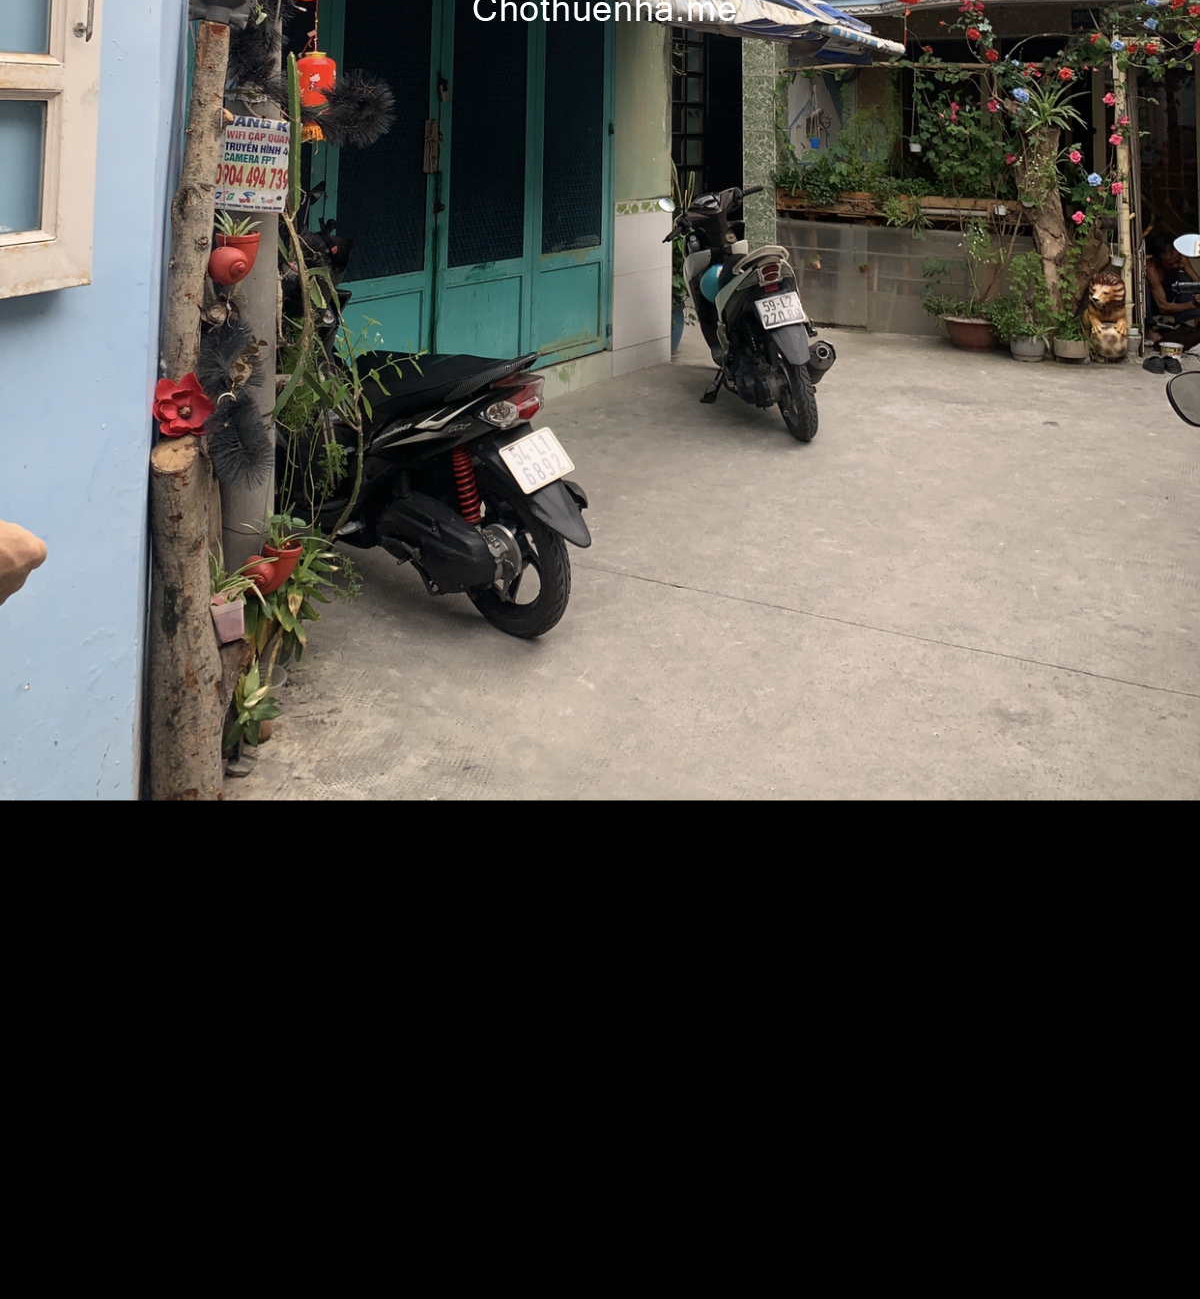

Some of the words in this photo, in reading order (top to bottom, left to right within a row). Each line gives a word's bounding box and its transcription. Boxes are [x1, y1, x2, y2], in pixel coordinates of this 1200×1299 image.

[224, 151, 259, 164] CAMERA
[260, 155, 277, 166] FPT
[245, 166, 267, 189] 494
[268, 168, 289, 191] 739
[762, 295, 794, 313] 59-L2
[509, 434, 552, 466] 54-L1
[522, 452, 566, 486] 6892
